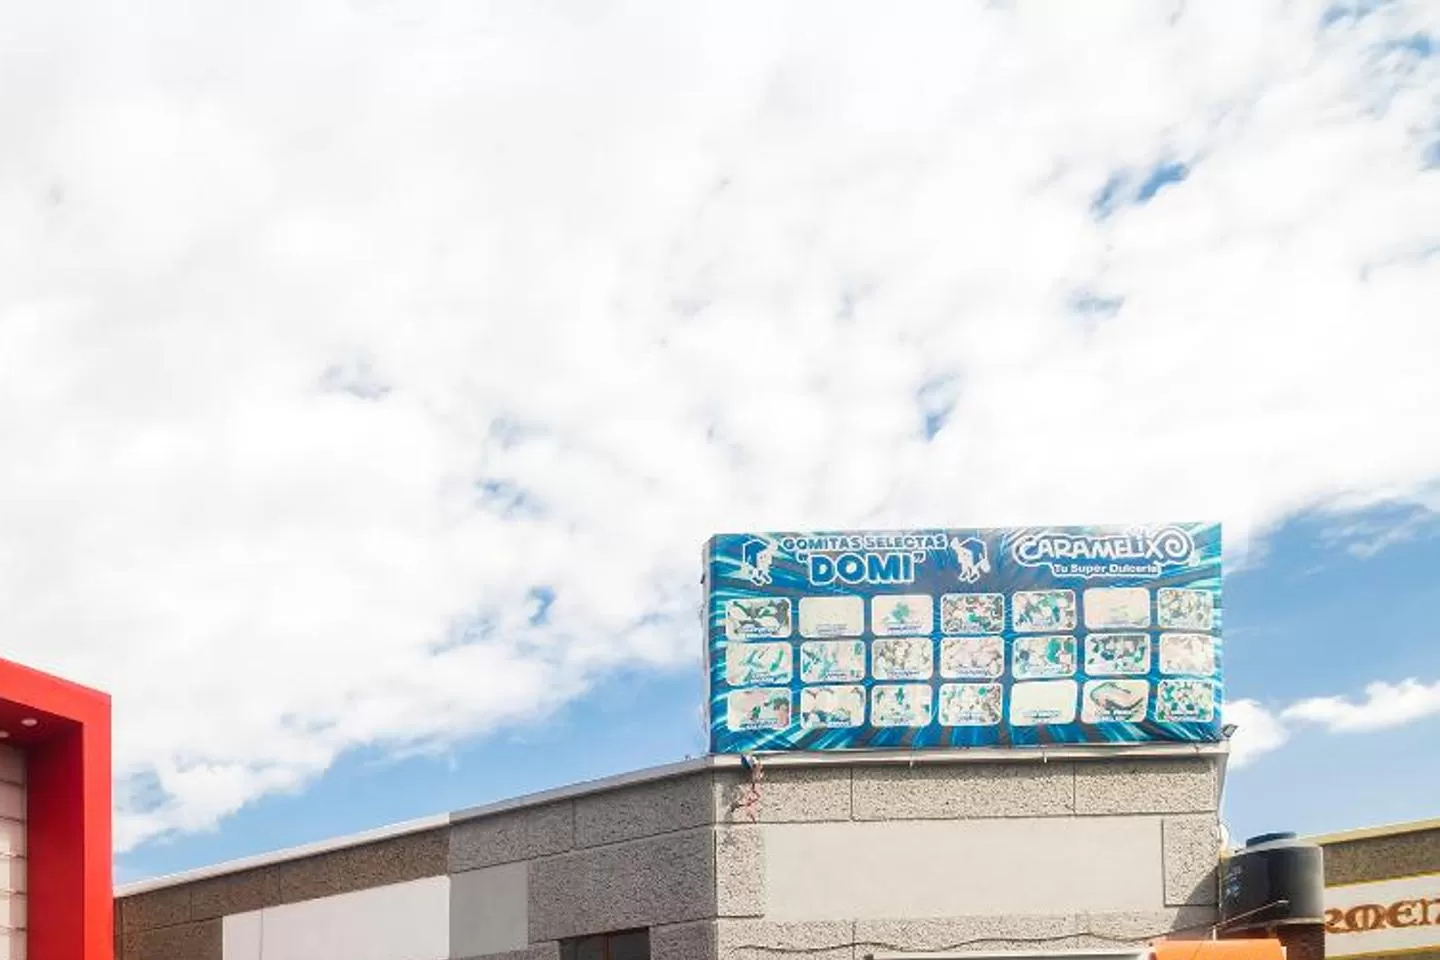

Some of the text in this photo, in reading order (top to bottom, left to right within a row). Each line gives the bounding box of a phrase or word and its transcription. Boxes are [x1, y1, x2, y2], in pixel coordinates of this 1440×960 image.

[782, 534, 947, 550] GOMITAS SELECTAS
[1054, 563, 1068, 573] Tu
[1071, 563, 1107, 576] Super
